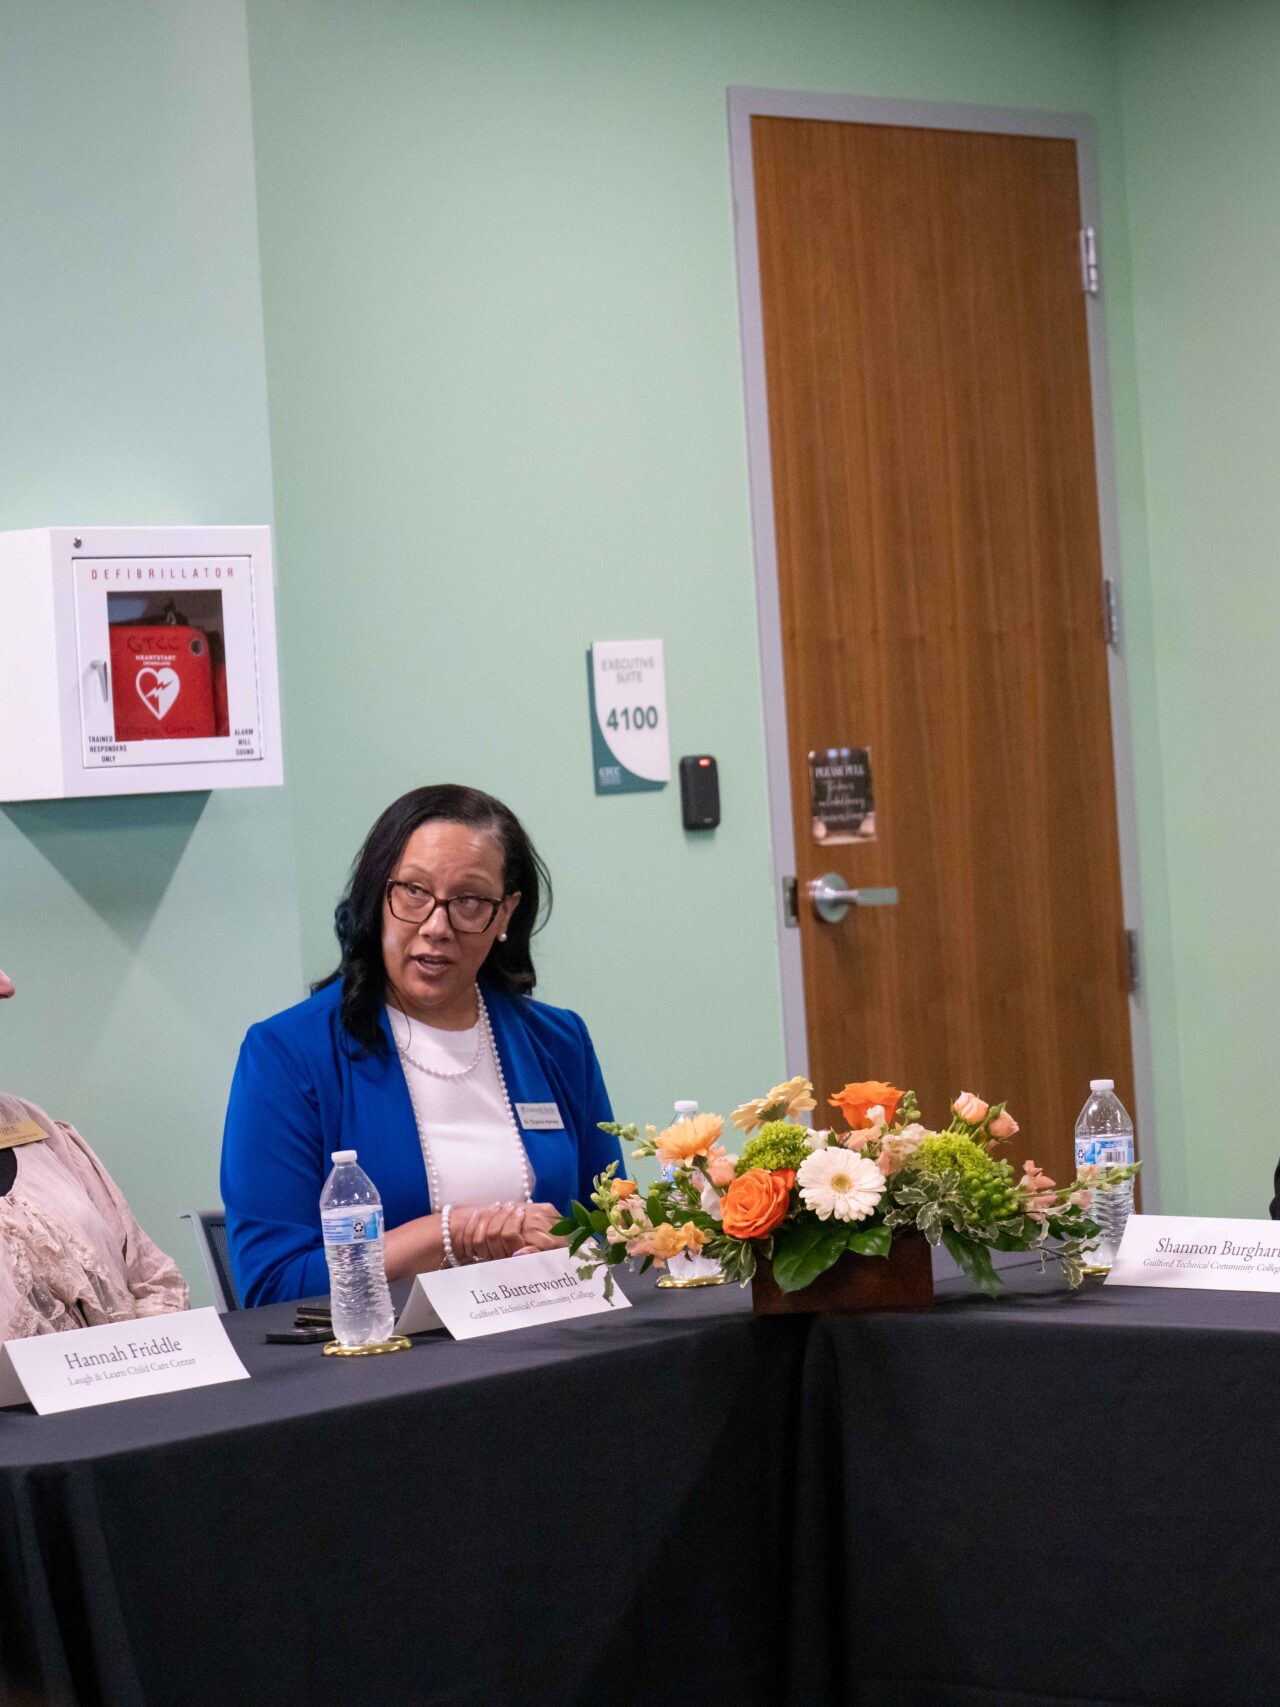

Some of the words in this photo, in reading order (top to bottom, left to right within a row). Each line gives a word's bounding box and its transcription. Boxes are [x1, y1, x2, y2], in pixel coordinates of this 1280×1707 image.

[91, 567, 235, 580] DEFIBRILLATOR
[601, 656, 655, 672] EXECUTIVE
[616, 670, 642, 683] SUITE
[606, 705, 658, 731] 4100
[88, 735, 113, 743] TRAINED
[234, 728, 253, 736] ALARM
[89, 744, 127, 753] RESPONDERS
[238, 738, 251, 746] WILL
[101, 755, 116, 763] ONLY
[235, 748, 254, 756] SOUND
[1155, 1237, 1218, 1256] Shannon
[1143, 1258, 1175, 1269] Guilford
[1175, 1259, 1209, 1270] Technical
[1210, 1260, 1256, 1274] Community
[470, 1284, 501, 1305] Lisa
[498, 1272, 578, 1300] Butterworth
[470, 1306, 500, 1321] Guilford
[499, 1301, 531, 1316] Technical
[530, 1294, 572, 1311] Community
[570, 1289, 597, 1304] College
[64, 1345, 127, 1371] Hannah
[127, 1335, 183, 1360] Friddle
[67, 1373, 94, 1387] Laugh
[103, 1367, 127, 1381] Learn
[127, 1363, 150, 1376] Child
[150, 1359, 170, 1372] Care
[170, 1356, 197, 1369] Center
